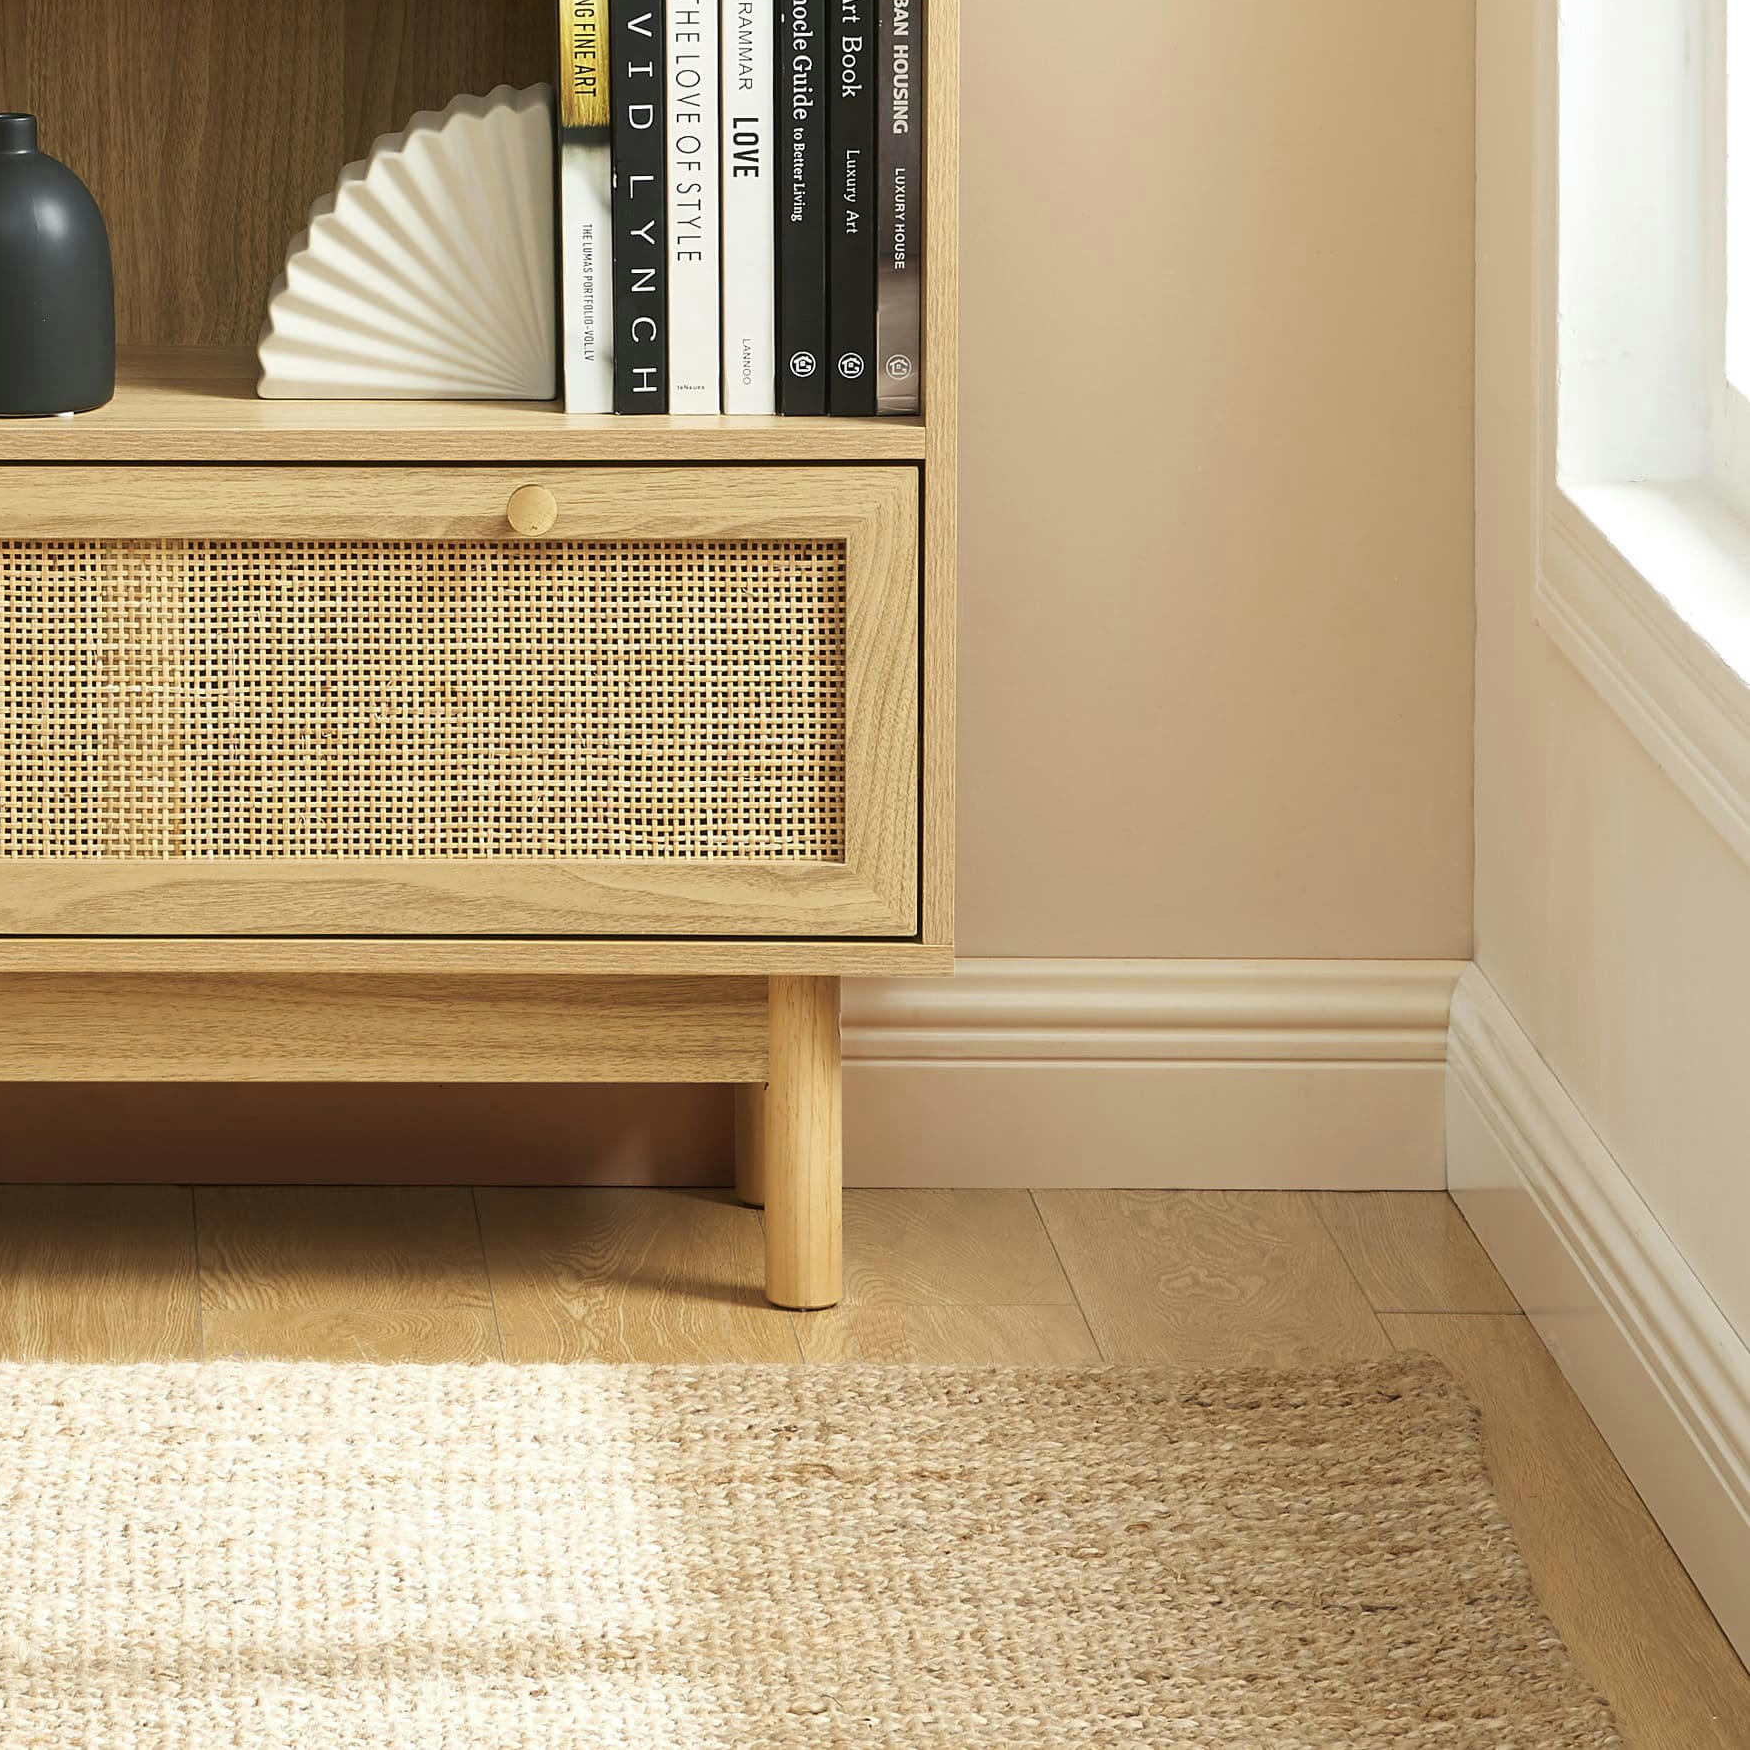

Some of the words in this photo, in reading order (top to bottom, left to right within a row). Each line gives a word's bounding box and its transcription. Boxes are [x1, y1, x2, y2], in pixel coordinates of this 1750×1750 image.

[574, 24, 596, 59] FINE
[575, 65, 597, 97] ART
[675, 55, 701, 123] LOVE
[792, 55, 813, 120] Guide
[841, 36, 863, 98] Book
[892, 45, 909, 135] HOUSING
[676, 135, 702, 172] OF
[732, 117, 760, 178] LOVE
[793, 128, 804, 140] to
[793, 143, 805, 181] Better
[843, 149, 860, 203] Luxury
[790, 183, 806, 222] Living
[894, 168, 906, 221] LUXURY
[582, 224, 593, 240] THE
[676, 182, 702, 262] STYLE
[846, 210, 860, 234] Art
[582, 242, 593, 273] LUMAS
[893, 224, 906, 270] HOUSE
[629, 174, 658, 393] LYNCH
[742, 338, 752, 385] LANNOO
